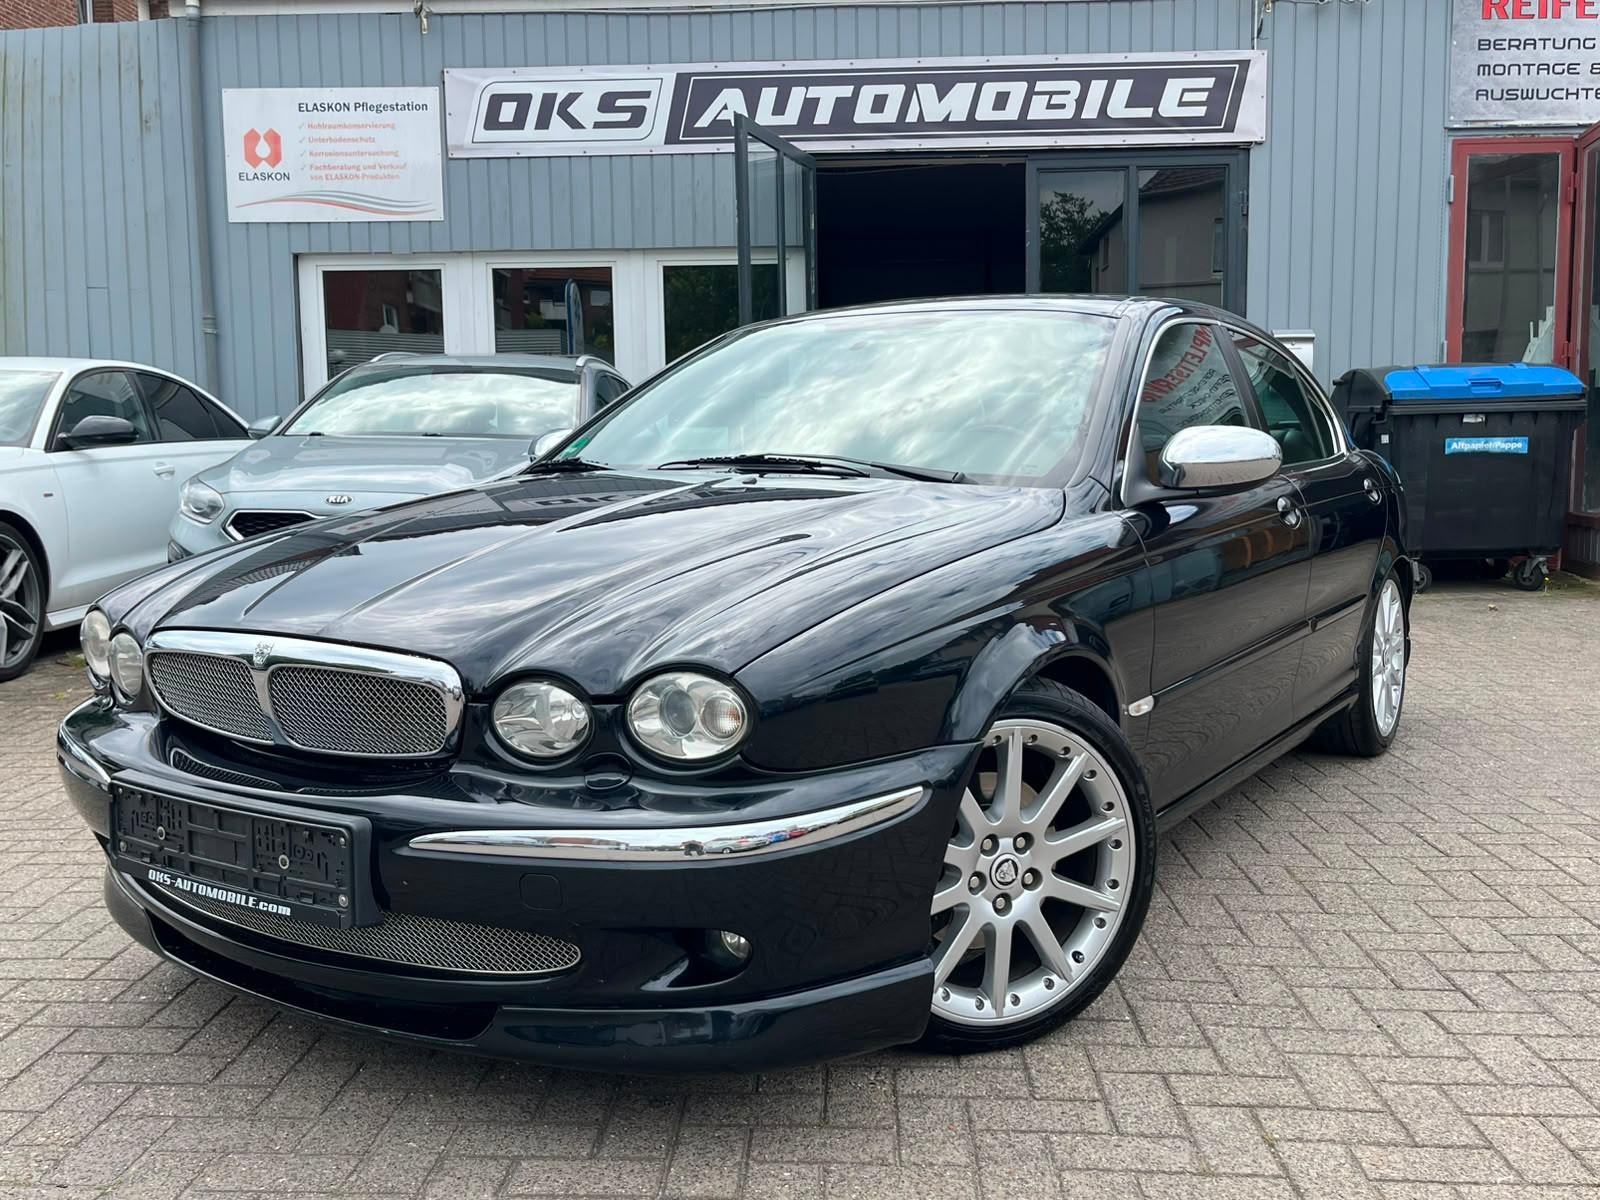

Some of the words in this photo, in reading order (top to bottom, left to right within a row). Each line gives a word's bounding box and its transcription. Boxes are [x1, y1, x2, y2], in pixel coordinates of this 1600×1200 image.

[1477, 37, 1596, 51] BERATUNG
[1477, 62, 1581, 76] MONTAGE
[298, 102, 350, 113] ELASKON
[354, 101, 428, 114] Pflegestation
[483, 90, 652, 131] OKS
[693, 77, 1216, 129] AUTOMOBILE
[238, 172, 290, 181] ELASKON
[328, 495, 349, 503] KIA
[147, 869, 292, 917] OKS-AUTOMOBILE.com
